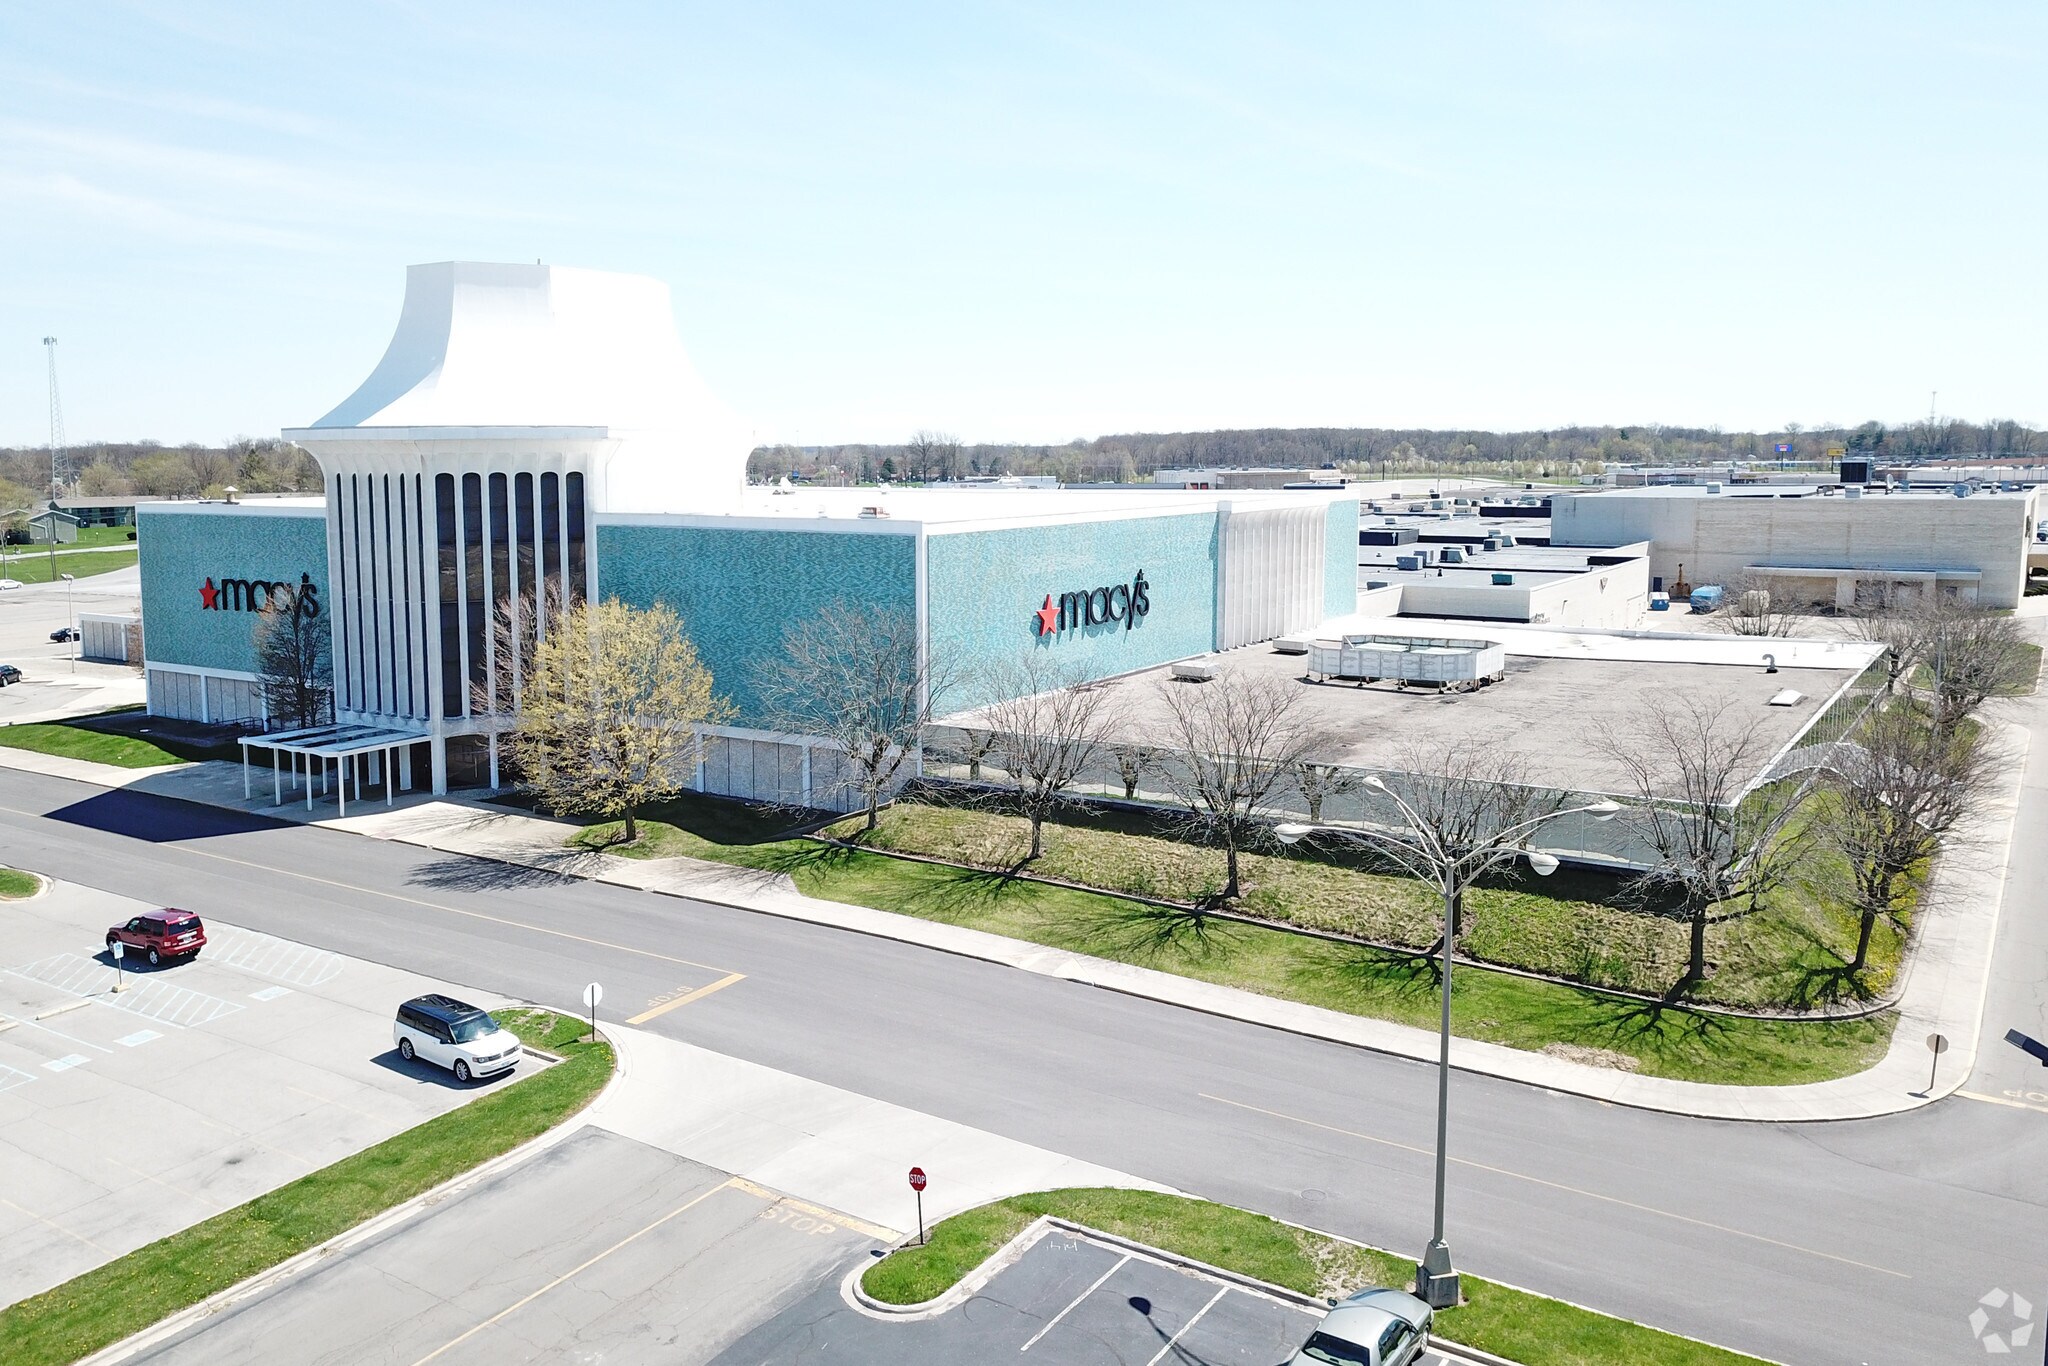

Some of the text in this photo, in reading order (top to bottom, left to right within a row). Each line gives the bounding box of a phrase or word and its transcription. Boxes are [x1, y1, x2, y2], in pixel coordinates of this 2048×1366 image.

[1060, 568, 1150, 631] macy's
[647, 985, 694, 1007] STOP
[910, 1173, 926, 1185] STOP
[762, 1206, 836, 1235] STOP
